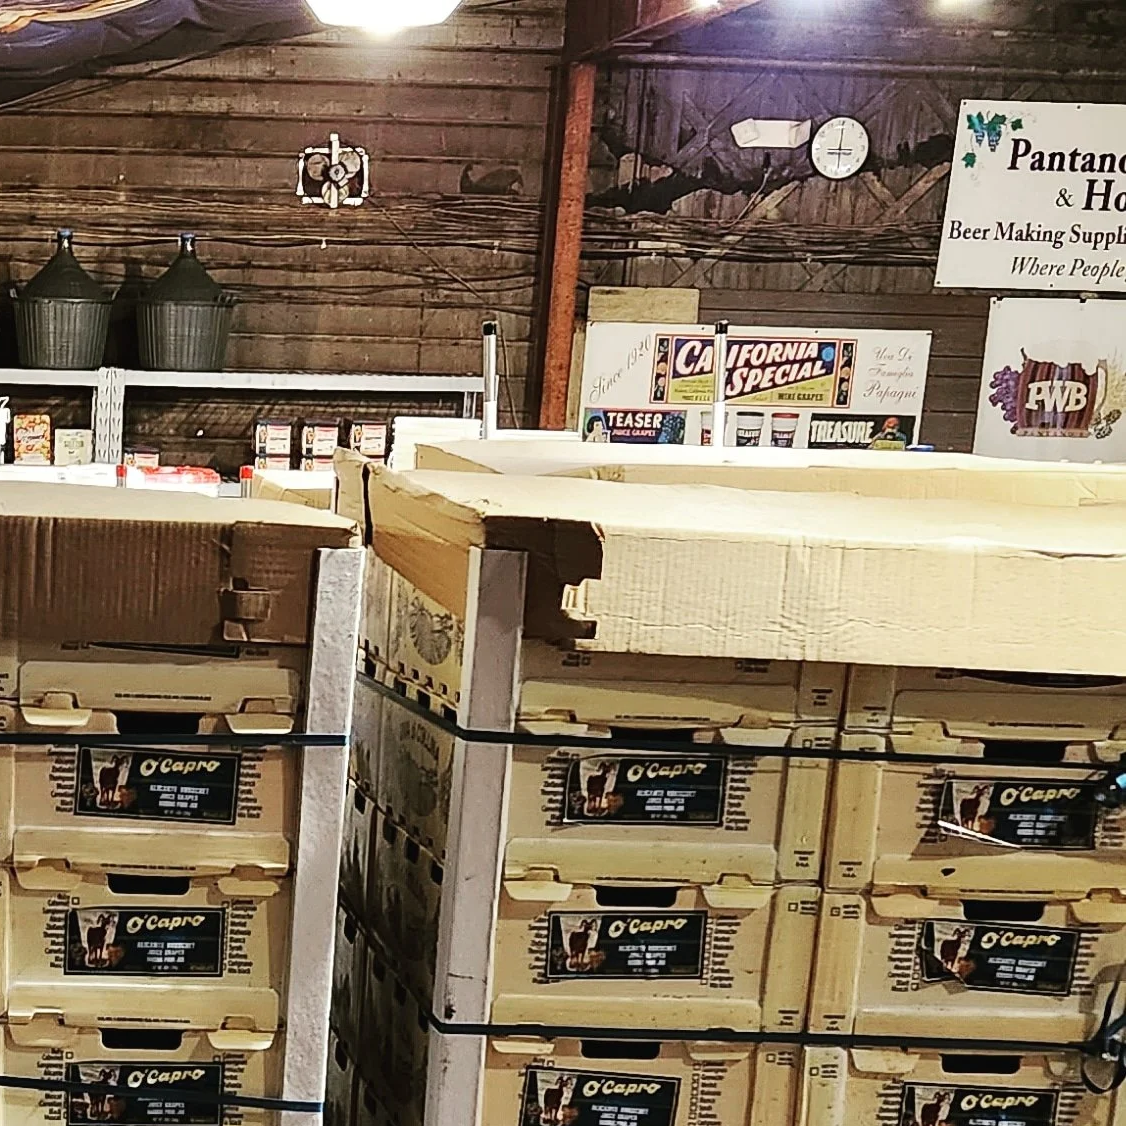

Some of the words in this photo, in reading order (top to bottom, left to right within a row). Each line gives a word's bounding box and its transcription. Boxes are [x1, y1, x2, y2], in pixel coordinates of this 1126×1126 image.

[1056, 188, 1075, 208] &
[1081, 179, 1126, 212] Ho
[948, 220, 990, 240] Beer
[993, 221, 1066, 249] Making
[1010, 256, 1065, 276] Where
[1069, 258, 1125, 284] People
[675, 340, 819, 375] CAIFORNIA
[590, 368, 623, 403] Since
[725, 360, 826, 397] SPECIAL
[863, 381, 919, 404] Papagni
[1025, 380, 1088, 412] PWB
[607, 412, 662, 429] TEASER
[811, 421, 874, 443] TREASURE
[140, 759, 220, 776] O'Capro
[627, 762, 707, 782] O'Capro
[1000, 787, 1080, 805] O'Capro
[126, 915, 205, 933] O'Capro
[608, 918, 687, 938] O'Capro
[981, 932, 1061, 949] O'Capro
[127, 1069, 205, 1087] O'Capro
[583, 1080, 661, 1097] O'Capro
[961, 1095, 1038, 1110] O'Capro
